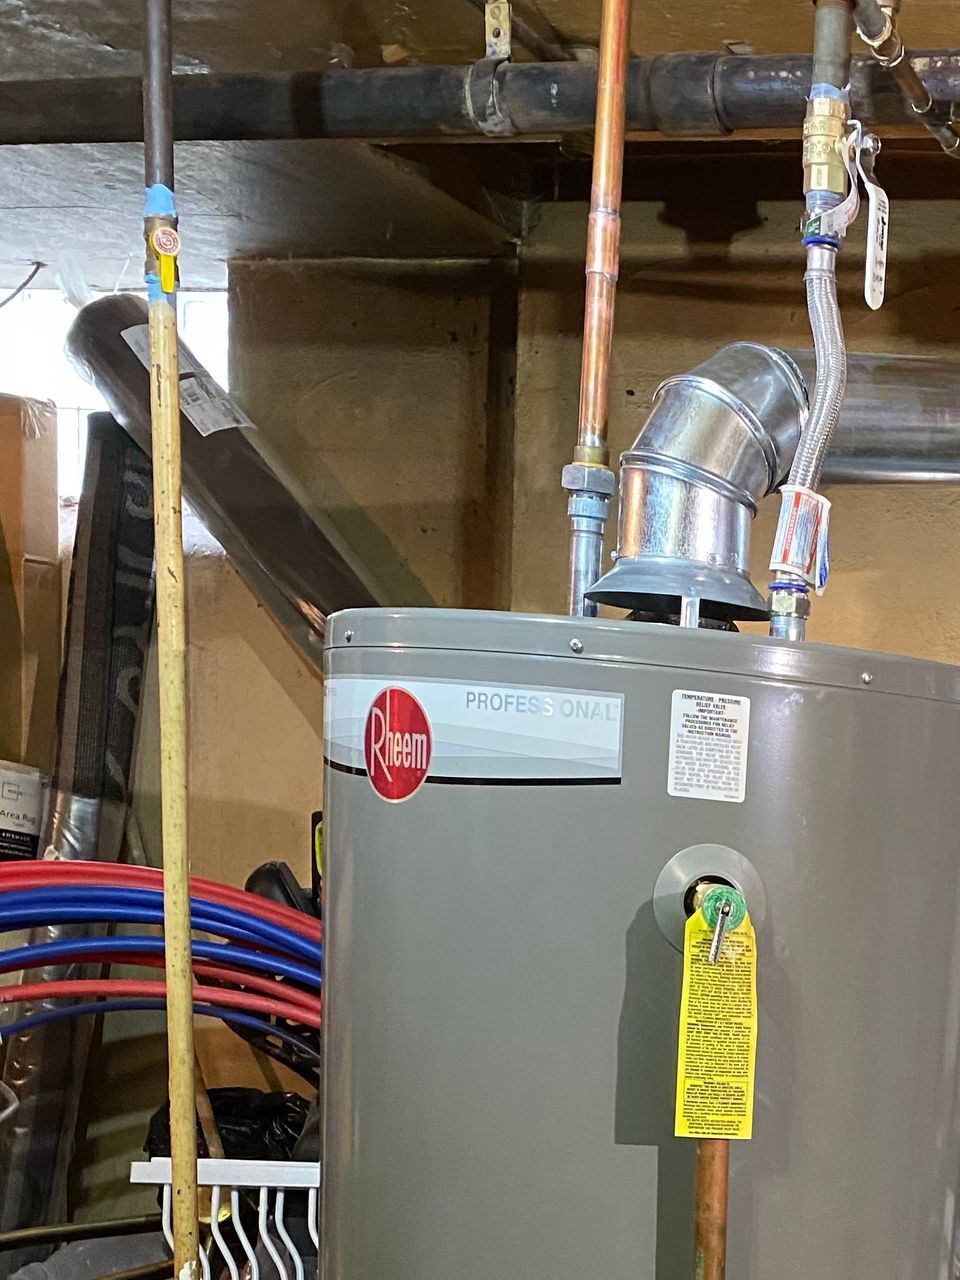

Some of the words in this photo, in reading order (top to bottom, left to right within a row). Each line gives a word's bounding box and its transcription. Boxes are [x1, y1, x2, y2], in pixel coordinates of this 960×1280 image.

[465, 690, 617, 722] PROFESSONAL
[682, 694, 714, 702] TEMPERATURE
[370, 689, 428, 782] Rheem
[0, 809, 20, 820] Area
